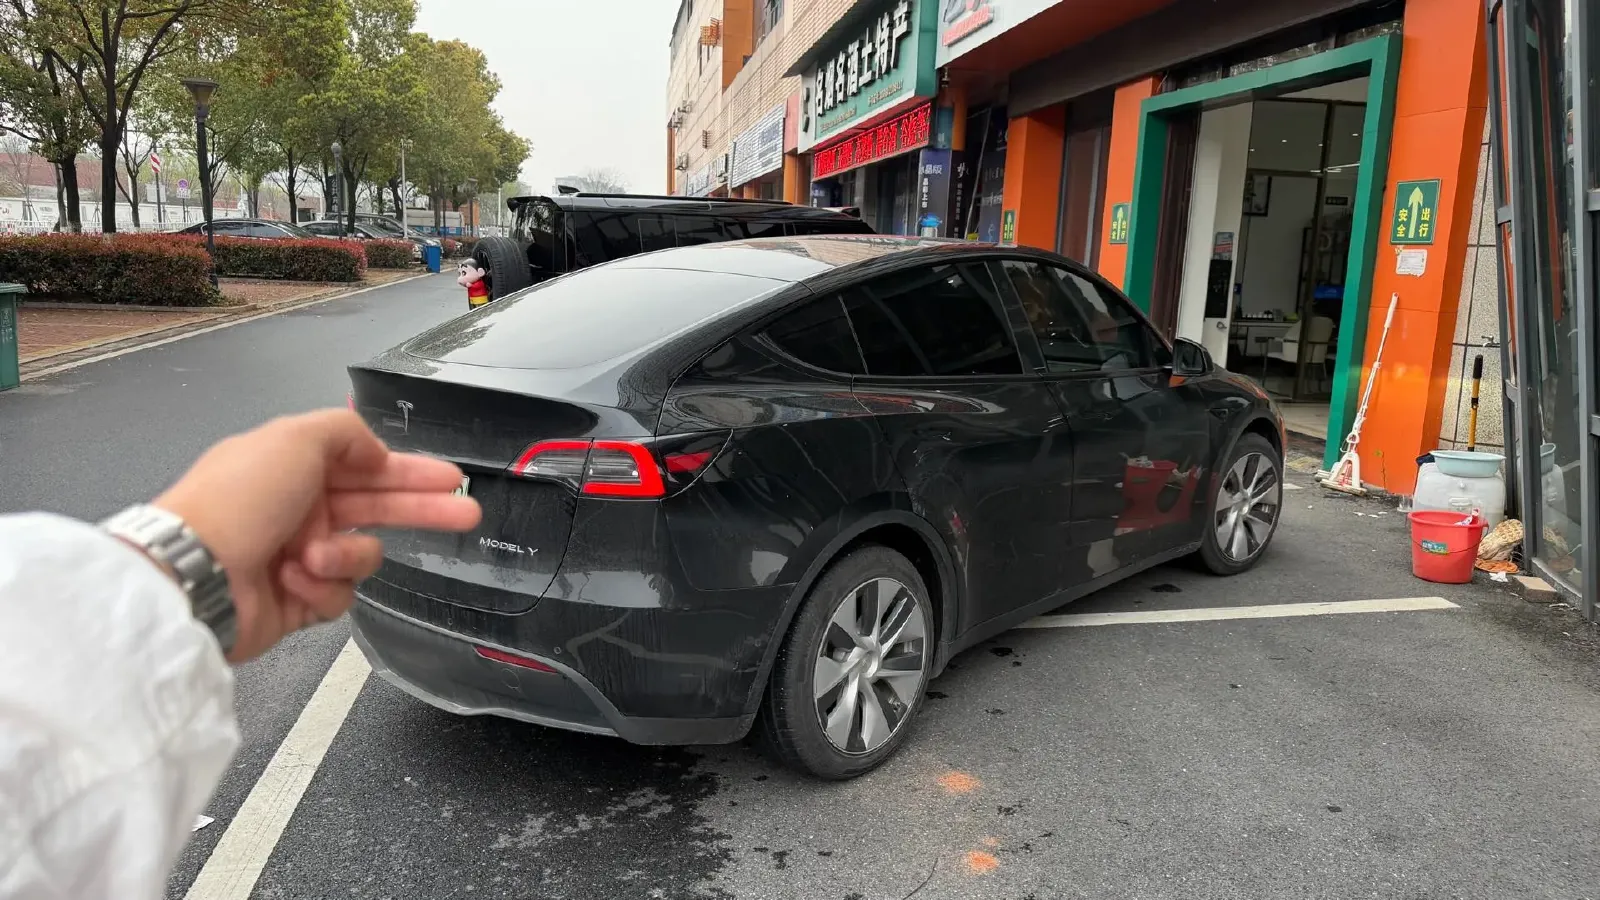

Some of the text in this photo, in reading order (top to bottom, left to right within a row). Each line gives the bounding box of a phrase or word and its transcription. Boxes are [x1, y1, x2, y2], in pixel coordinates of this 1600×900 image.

[814, 0, 910, 116] 名烟名酒土特产
[1396, 208, 1408, 238] 安全
[1418, 207, 1430, 238] 出行
[479, 536, 539, 556] MODEL Y
